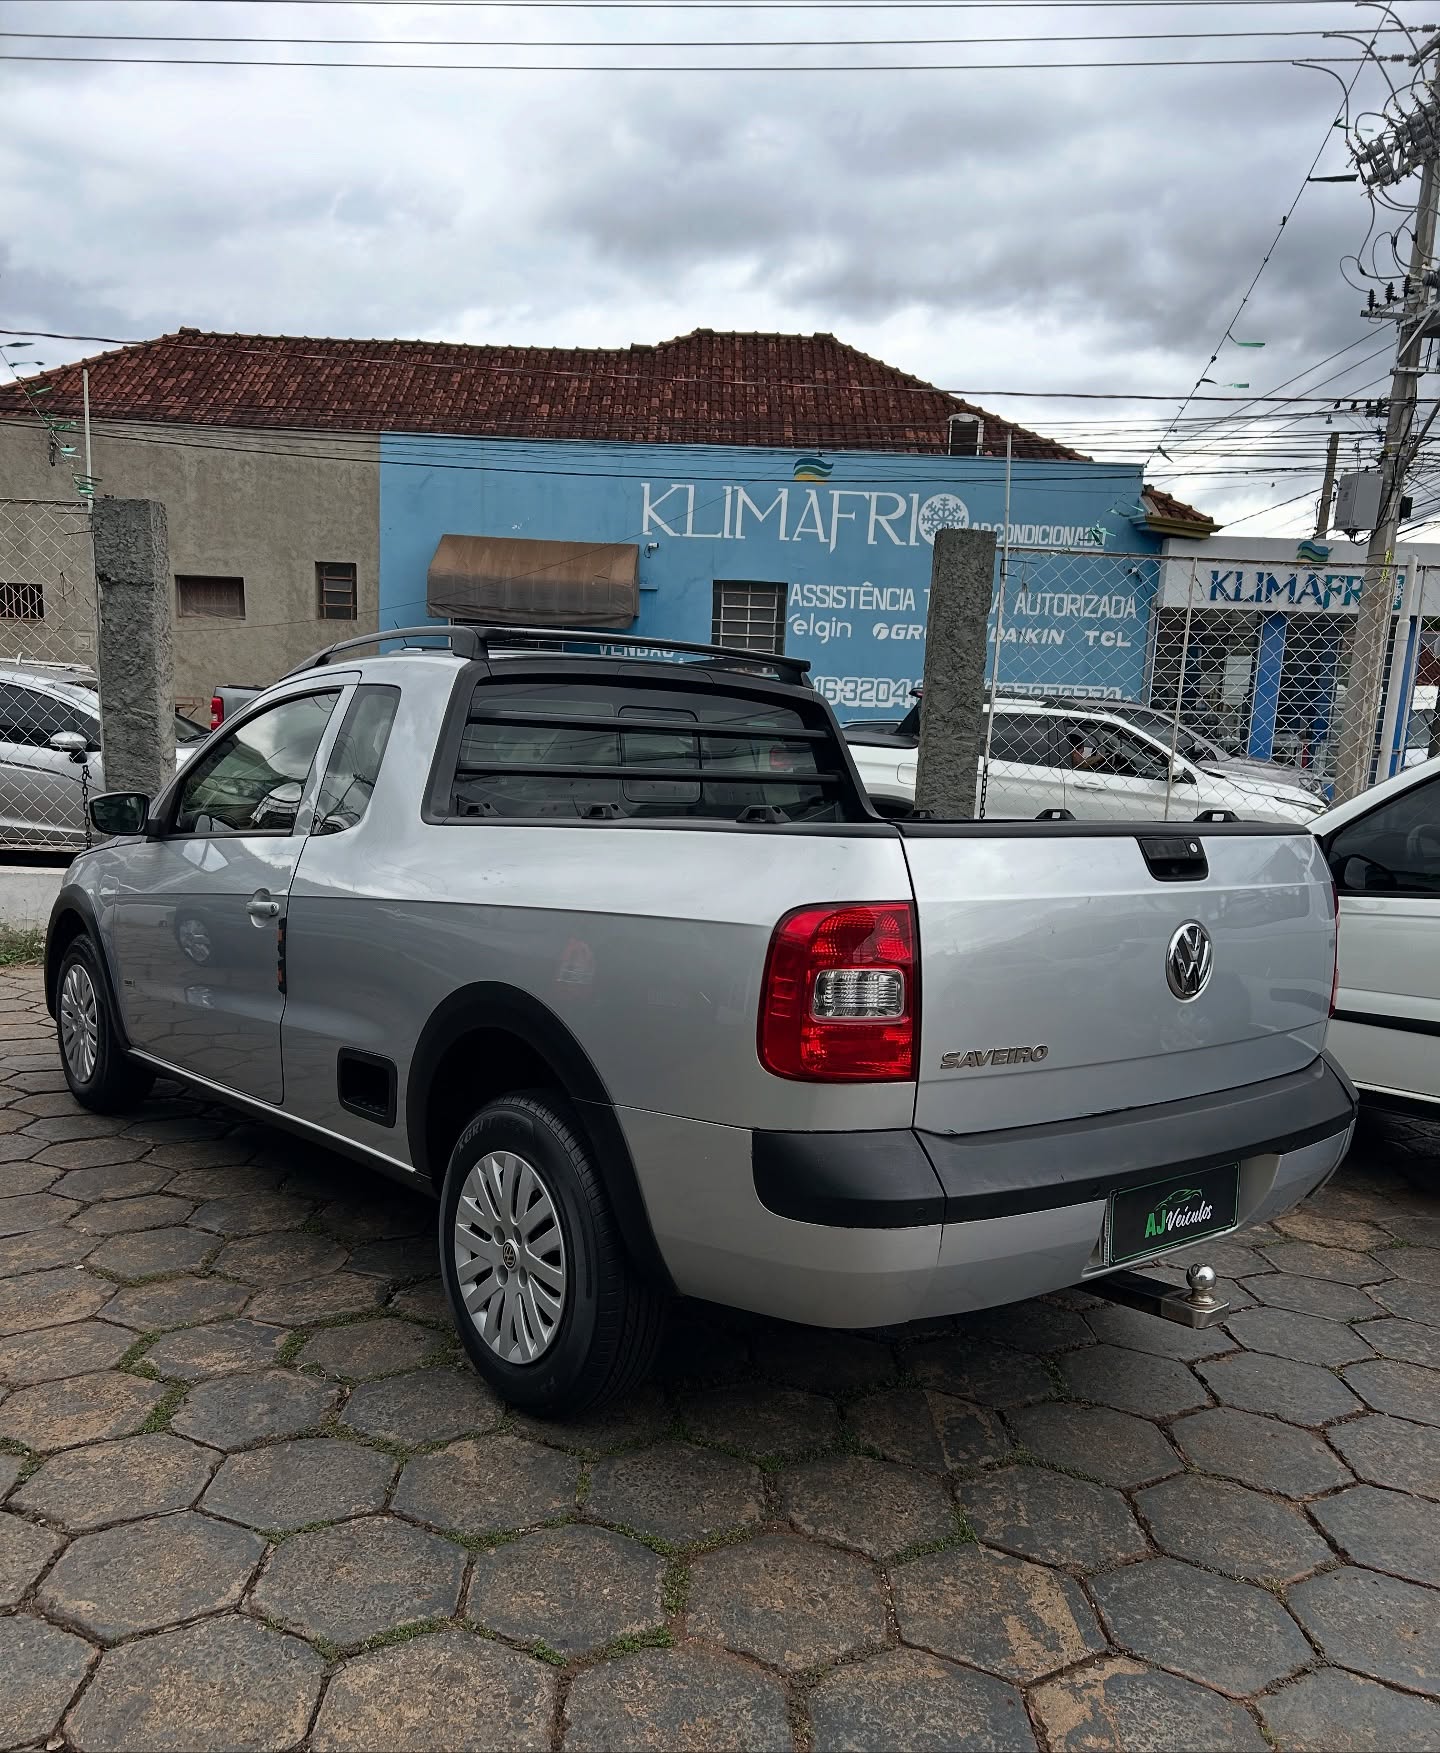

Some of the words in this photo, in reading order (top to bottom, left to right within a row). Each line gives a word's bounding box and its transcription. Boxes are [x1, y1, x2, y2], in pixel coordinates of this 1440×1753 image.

[789, 581, 916, 611] ASSISTÊNCIA
[1013, 591, 1137, 619] AUTORIZADA
[1209, 570, 1364, 611] KLIMAFR
[792, 613, 852, 644] elgin
[988, 627, 1065, 645] DAIKIN
[1084, 630, 1132, 648] TCL
[940, 1043, 1049, 1069] SAVEIRO
